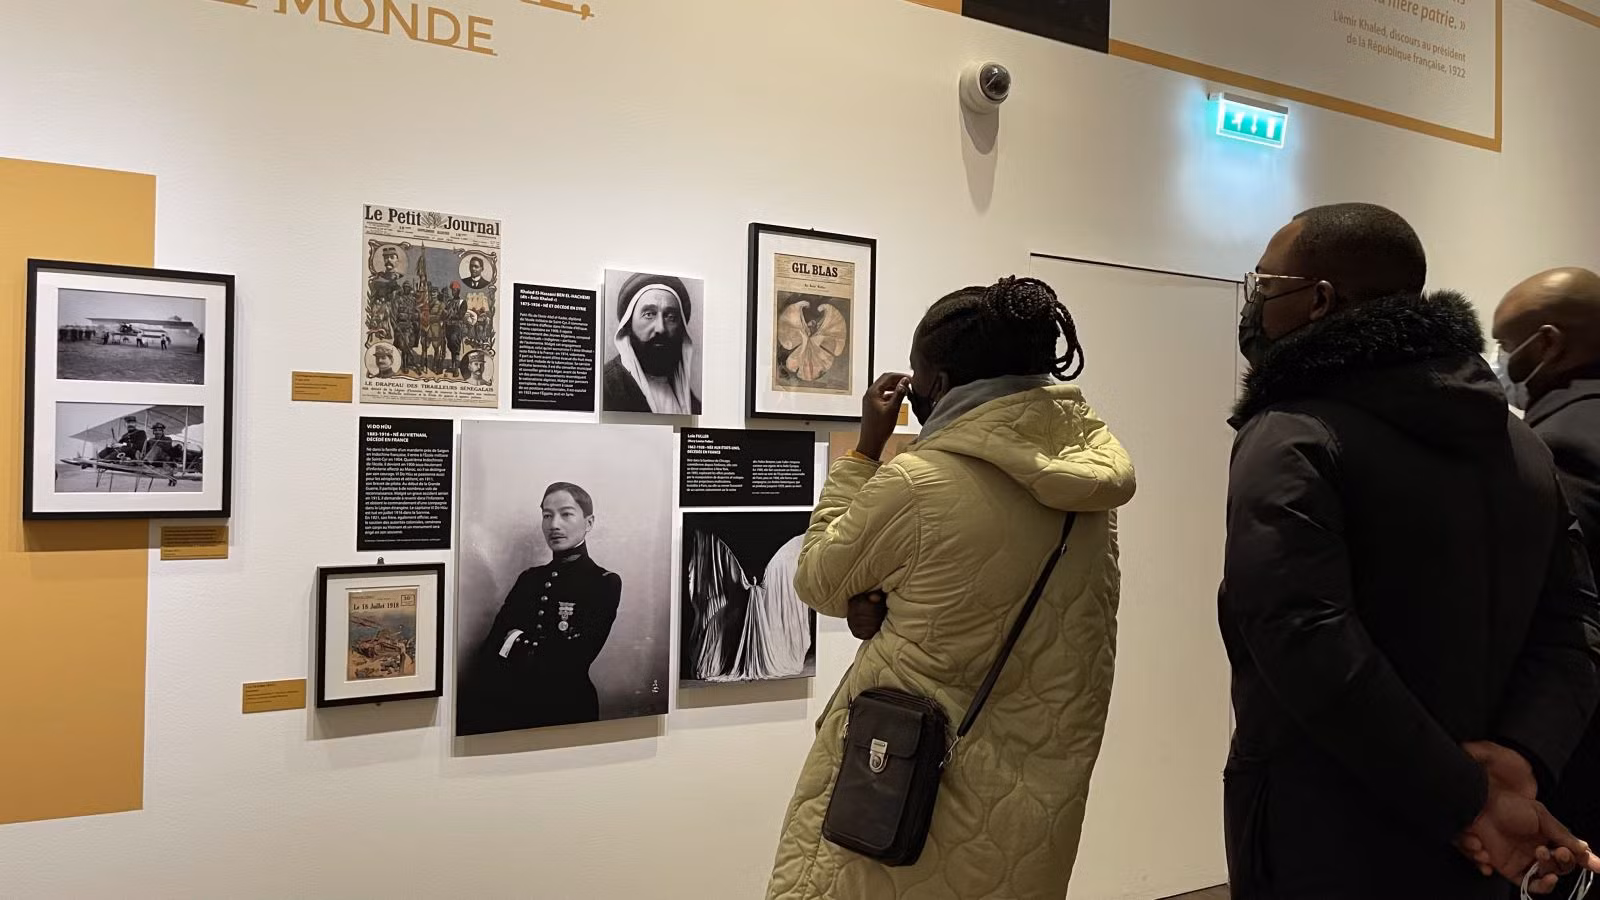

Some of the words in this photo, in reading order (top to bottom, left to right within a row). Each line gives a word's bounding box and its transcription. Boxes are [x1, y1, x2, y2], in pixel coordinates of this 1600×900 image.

[1421, 6, 1456, 29] patrie.
[1347, 32, 1357, 45] de
[1359, 36, 1366, 48] la
[1368, 39, 1412, 62] République
[1413, 52, 1447, 72] française,
[1449, 64, 1466, 78] 1922
[1359, 18, 1388, 38] Khaled,
[1390, 28, 1420, 47] discours
[1422, 42, 1431, 50] au
[1433, 44, 1466, 62] président
[365, 205, 383, 221] Le
[388, 208, 421, 226] Petit
[444, 216, 499, 236] Journal
[792, 262, 810, 274] GIL
[812, 265, 838, 278] BLAS
